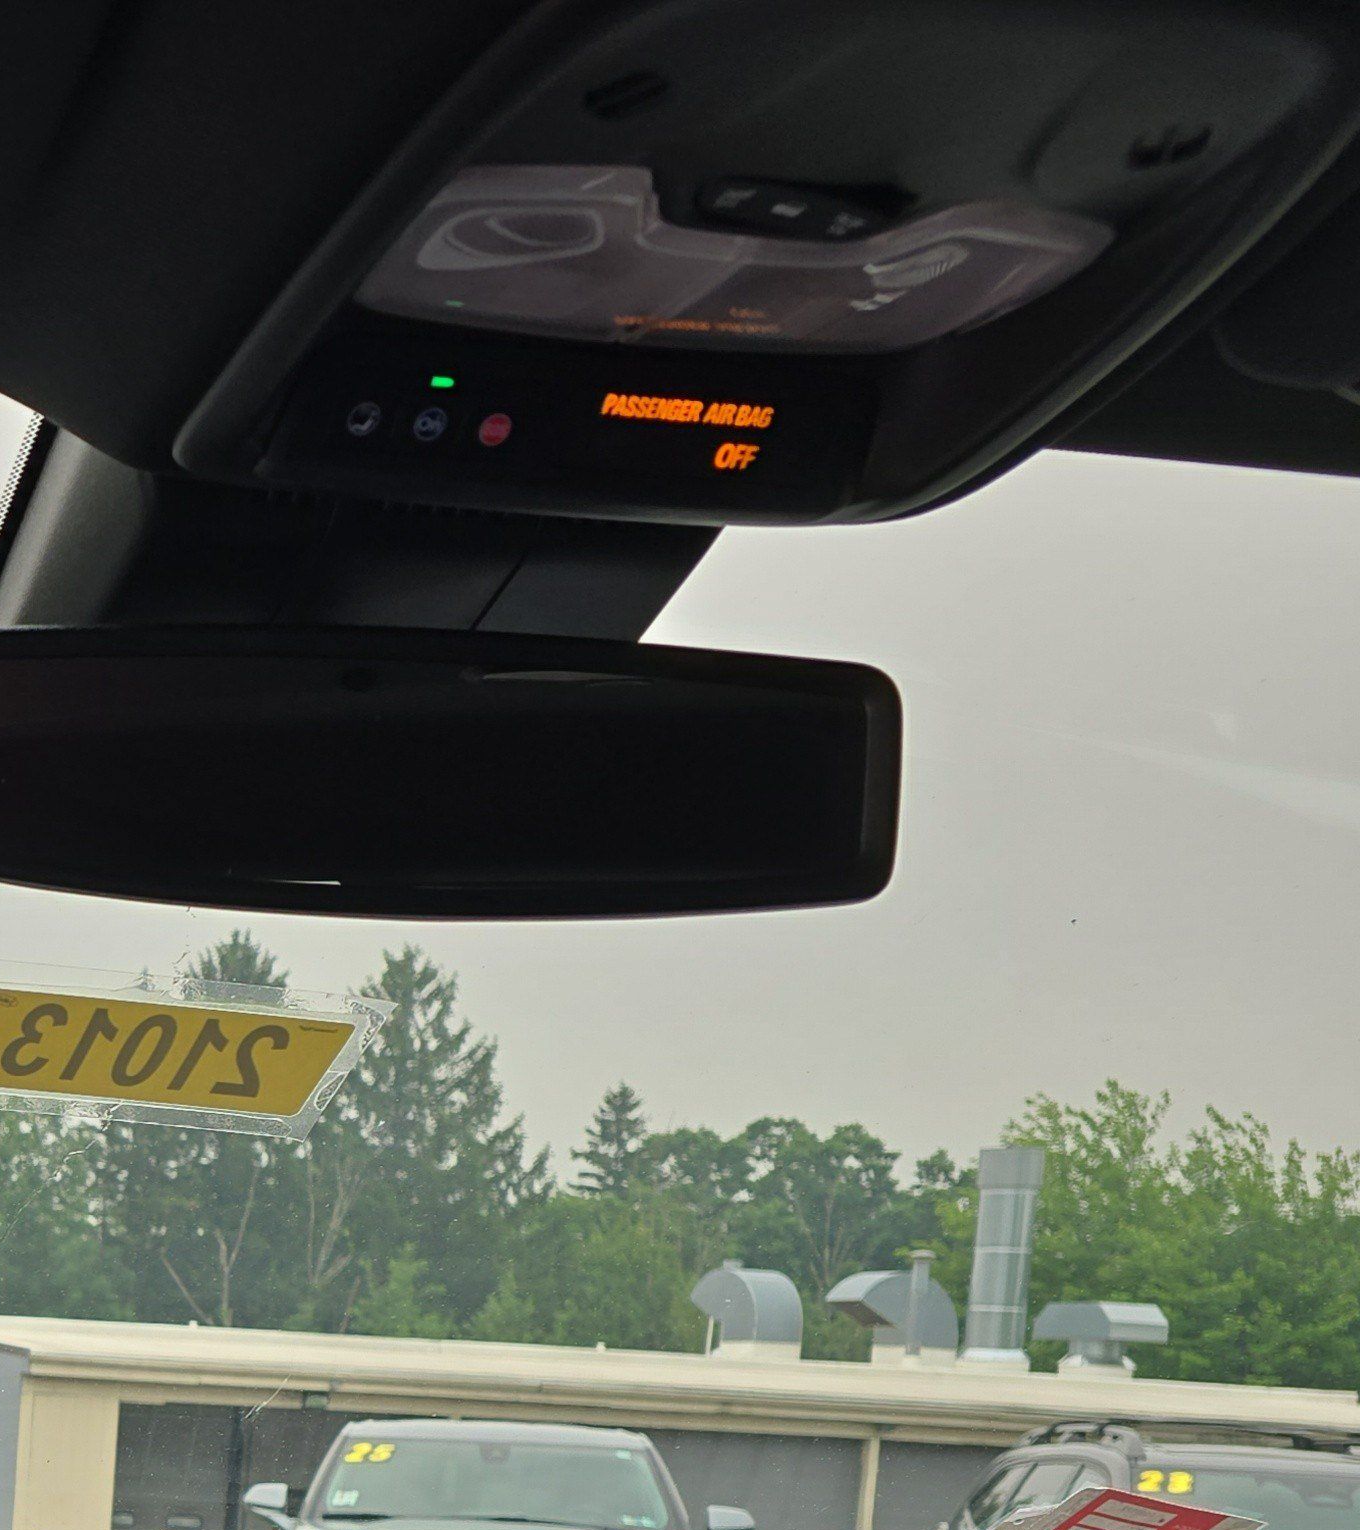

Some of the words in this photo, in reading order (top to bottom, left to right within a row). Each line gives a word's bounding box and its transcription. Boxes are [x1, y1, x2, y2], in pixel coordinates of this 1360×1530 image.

[600, 393, 702, 423] PASSENGER
[713, 442, 760, 471] OFF
[343, 1442, 396, 1464] 25
